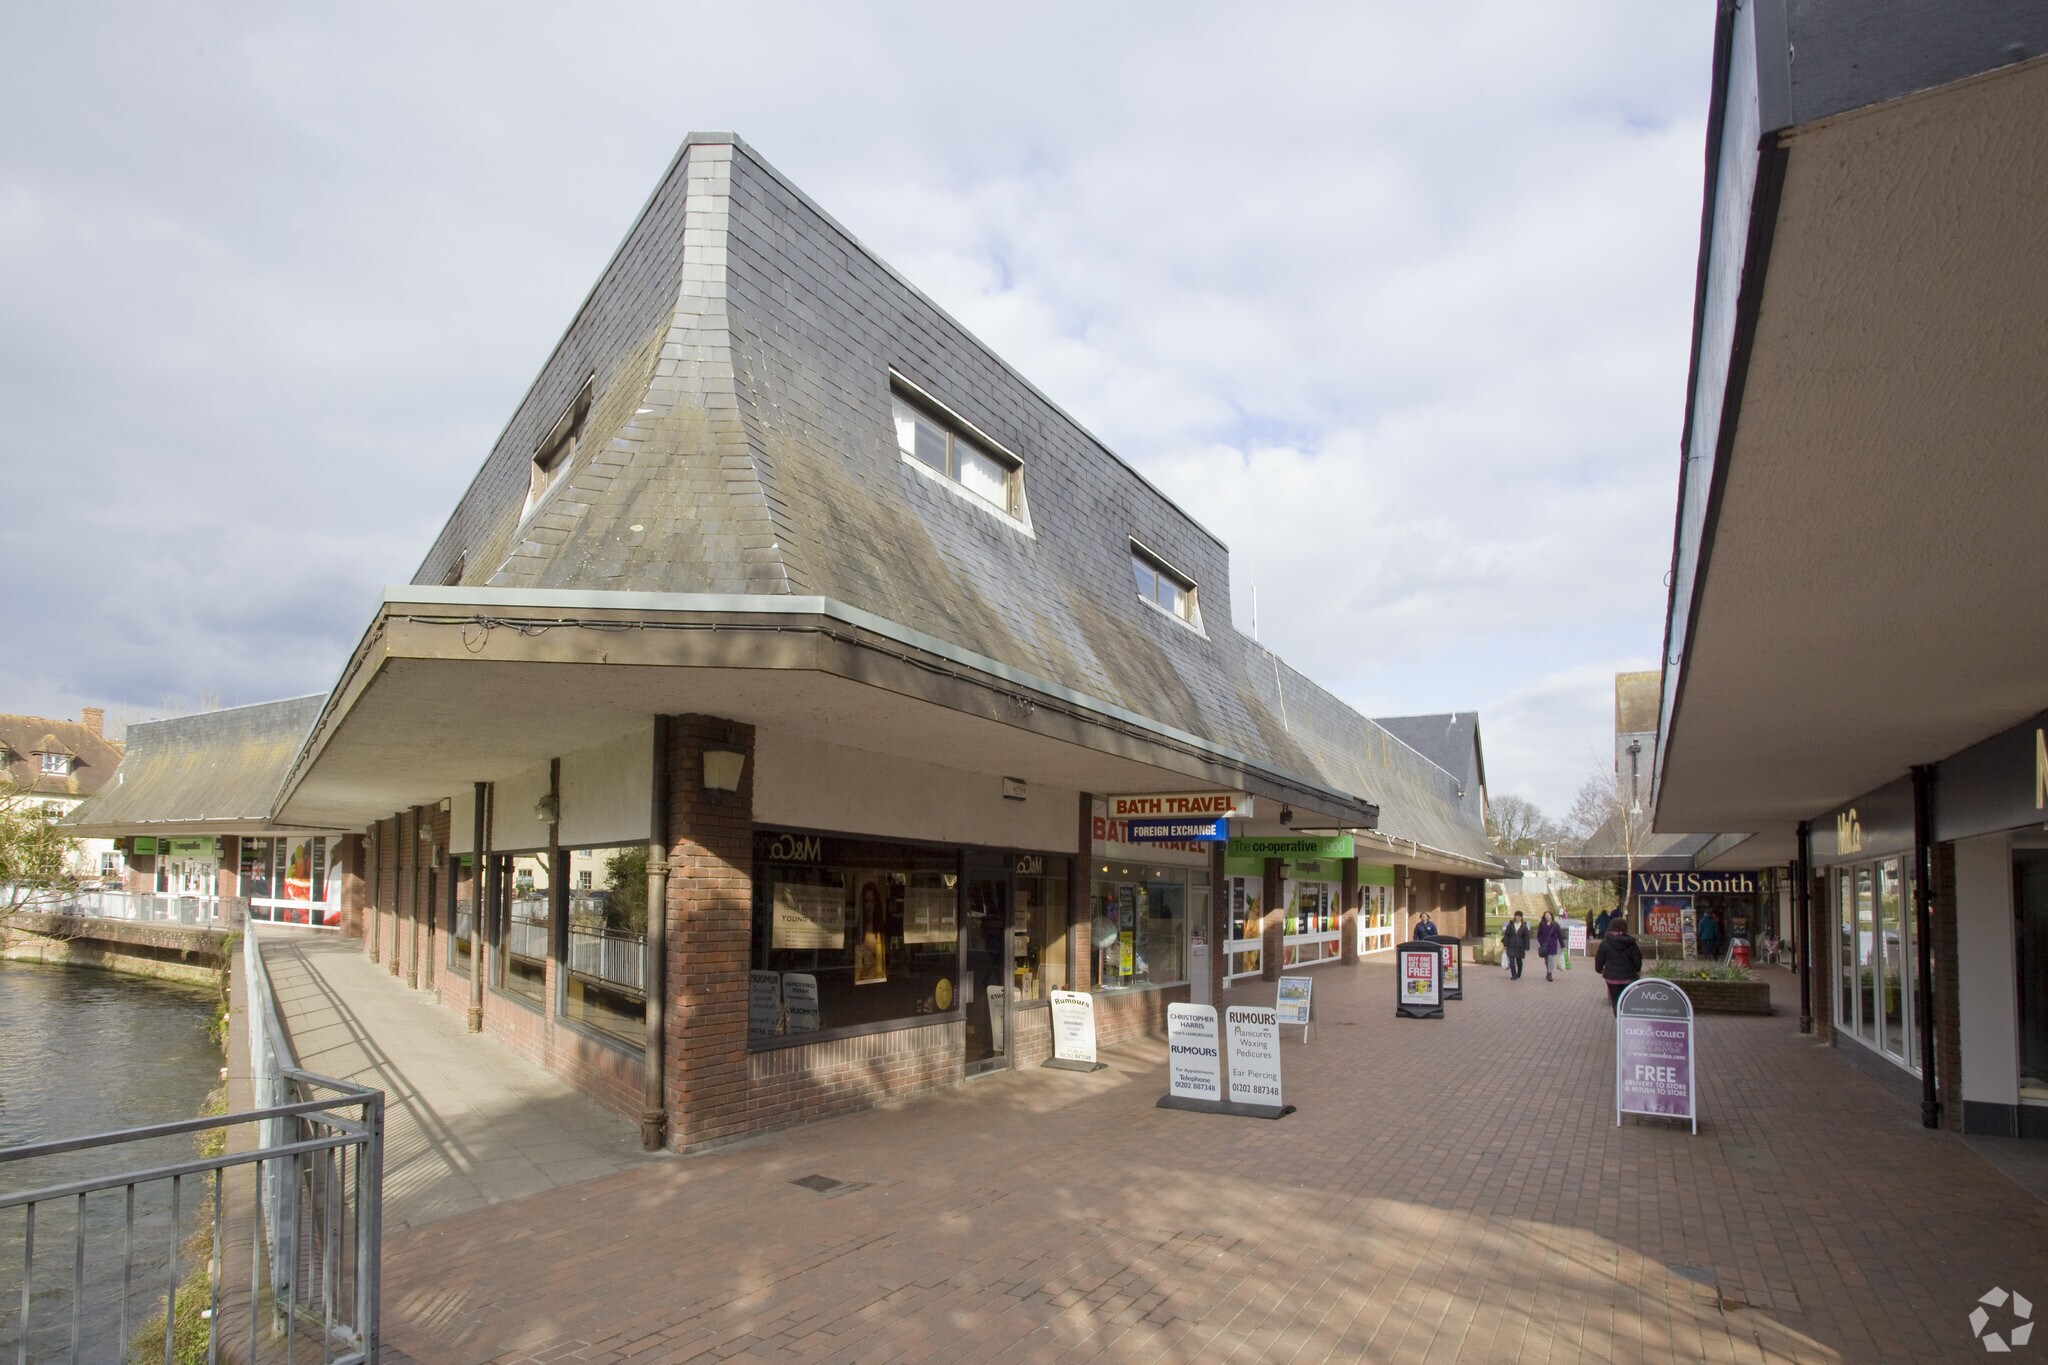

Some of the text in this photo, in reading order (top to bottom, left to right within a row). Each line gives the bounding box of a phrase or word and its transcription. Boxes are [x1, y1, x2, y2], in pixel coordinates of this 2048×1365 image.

[1116, 796, 1237, 814] BATH TRAVEL
[1093, 816, 1142, 845] BAT
[1134, 824, 1217, 837] FOREIGN EXCHANGE
[1235, 838, 1346, 854] The co-operative food
[1638, 872, 1755, 893] WHSmith
[1649, 917, 1681, 926] HALF
[1408, 968, 1431, 977] FREE
[1641, 991, 1669, 1001] M&Co
[1054, 997, 1090, 1008] Rumours
[1630, 1006, 1680, 1014] www.mandco.com
[1170, 1013, 1215, 1023] CHRISTOPHER
[1229, 1012, 1276, 1025] RUMOURS
[1234, 1026, 1272, 1038] Manicures
[1625, 1026, 1686, 1039] CLICK & COLLECT
[1240, 1038, 1268, 1050] Waxing
[1171, 1045, 1217, 1057] RUMOURS
[1236, 1049, 1272, 1059] Pedicures
[1632, 1052, 1686, 1060] www.mandco.com
[1179, 1074, 1211, 1083] Telephone
[1232, 1068, 1277, 1081] Ear Piercing
[1635, 1064, 1676, 1083] FREE
[1175, 1081, 1216, 1091] 01202 887348
[1625, 1079, 1654, 1087] DELIVERY
[1232, 1083, 1279, 1096] 01202 887348
[1631, 1086, 1656, 1094] RETURN
